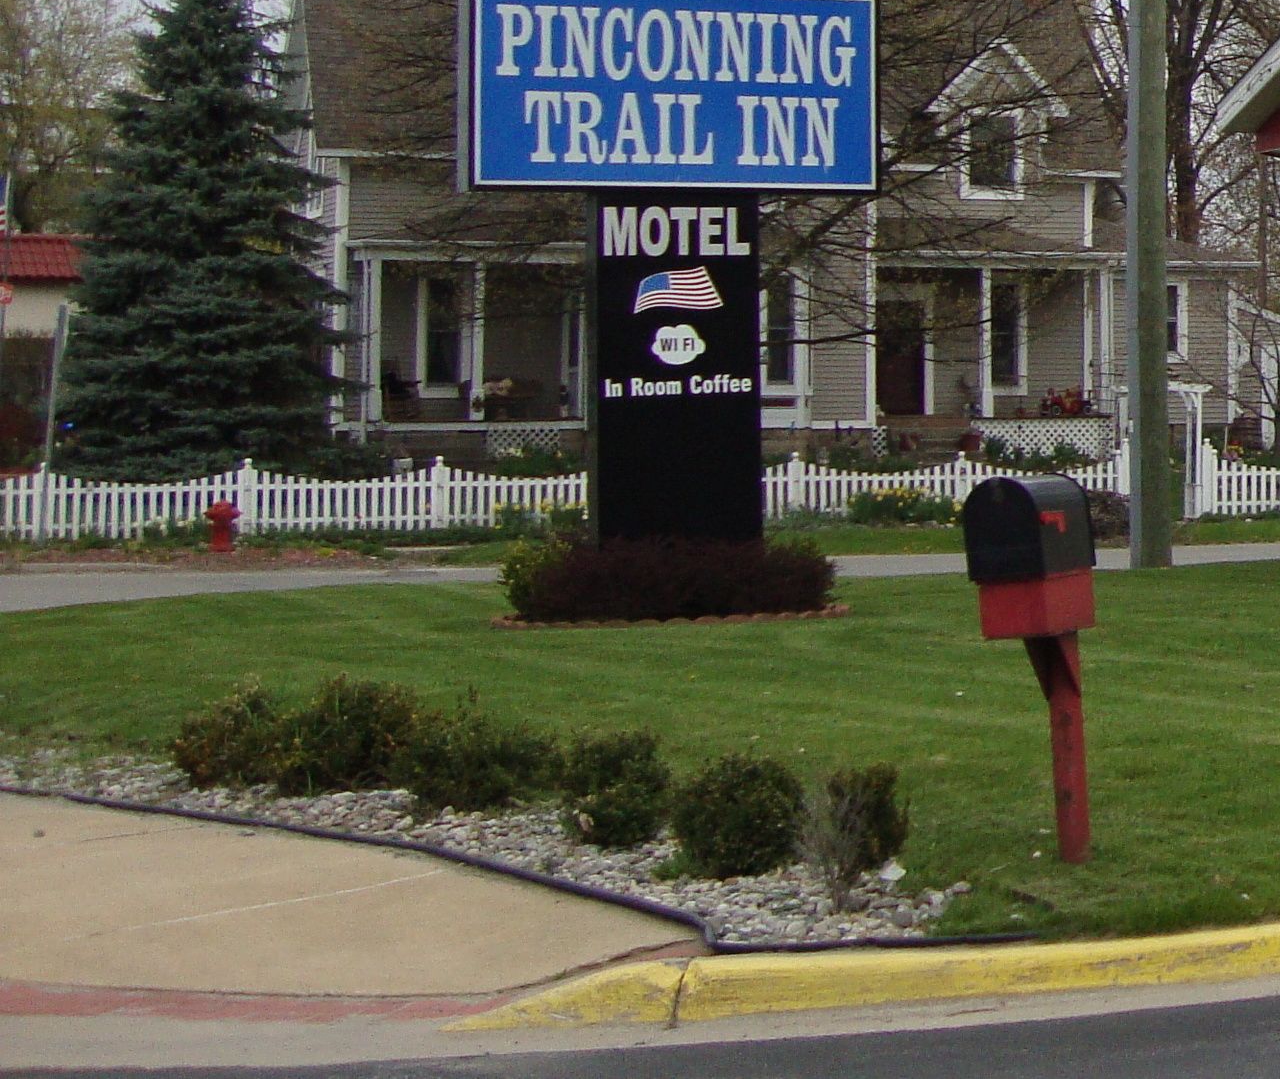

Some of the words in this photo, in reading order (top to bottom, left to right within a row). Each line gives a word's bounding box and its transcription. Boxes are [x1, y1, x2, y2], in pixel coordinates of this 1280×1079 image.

[495, 3, 856, 88] PINCONNING
[524, 90, 714, 165] TRAIL
[736, 95, 839, 167] INN
[602, 205, 750, 257] MOTEL
[660, 338, 678, 352] WI
[683, 338, 695, 351] FI
[604, 379, 623, 398] In
[630, 378, 682, 396] Room
[690, 374, 752, 394] Coffee
